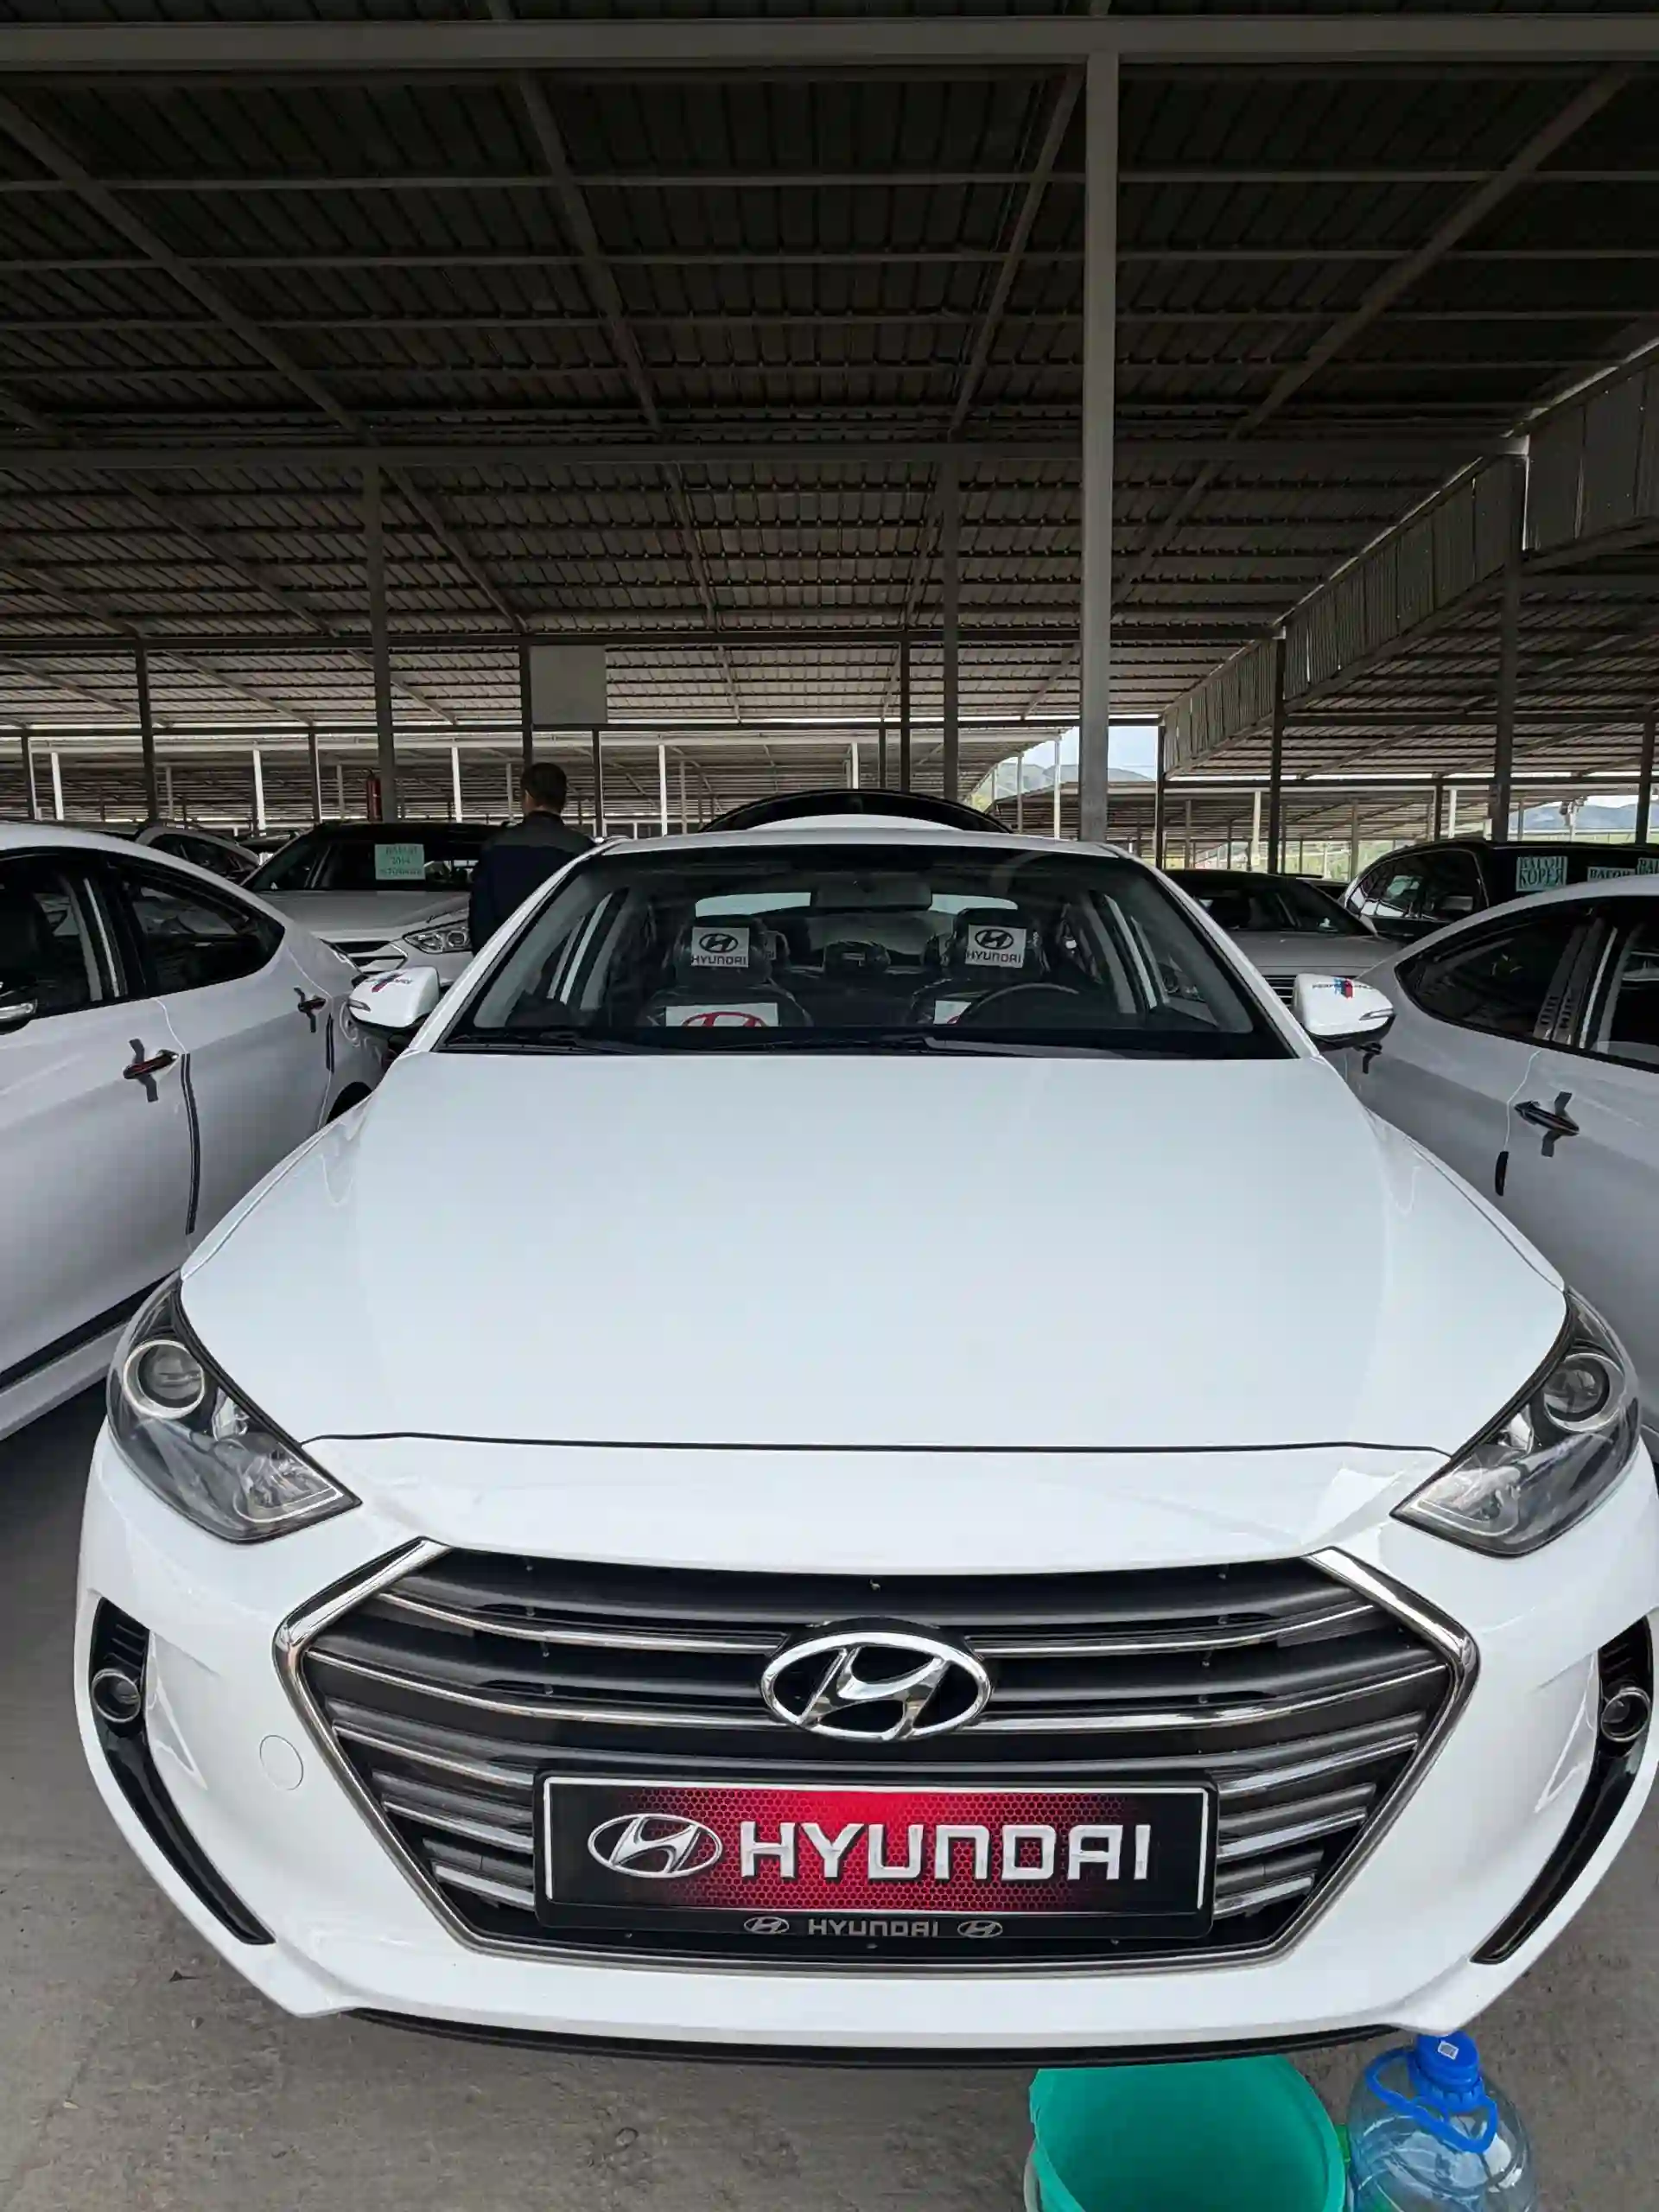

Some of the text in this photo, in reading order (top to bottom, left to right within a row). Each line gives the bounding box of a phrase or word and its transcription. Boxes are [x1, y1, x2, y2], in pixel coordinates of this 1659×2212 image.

[1519, 868, 1564, 887] КОРЕЯ
[691, 954, 747, 965] HYUNDAI
[966, 950, 1022, 963] HYUNDAI
[740, 1820, 1152, 1881] HYUNDAI
[808, 1918, 938, 1937] HYUNDAI
